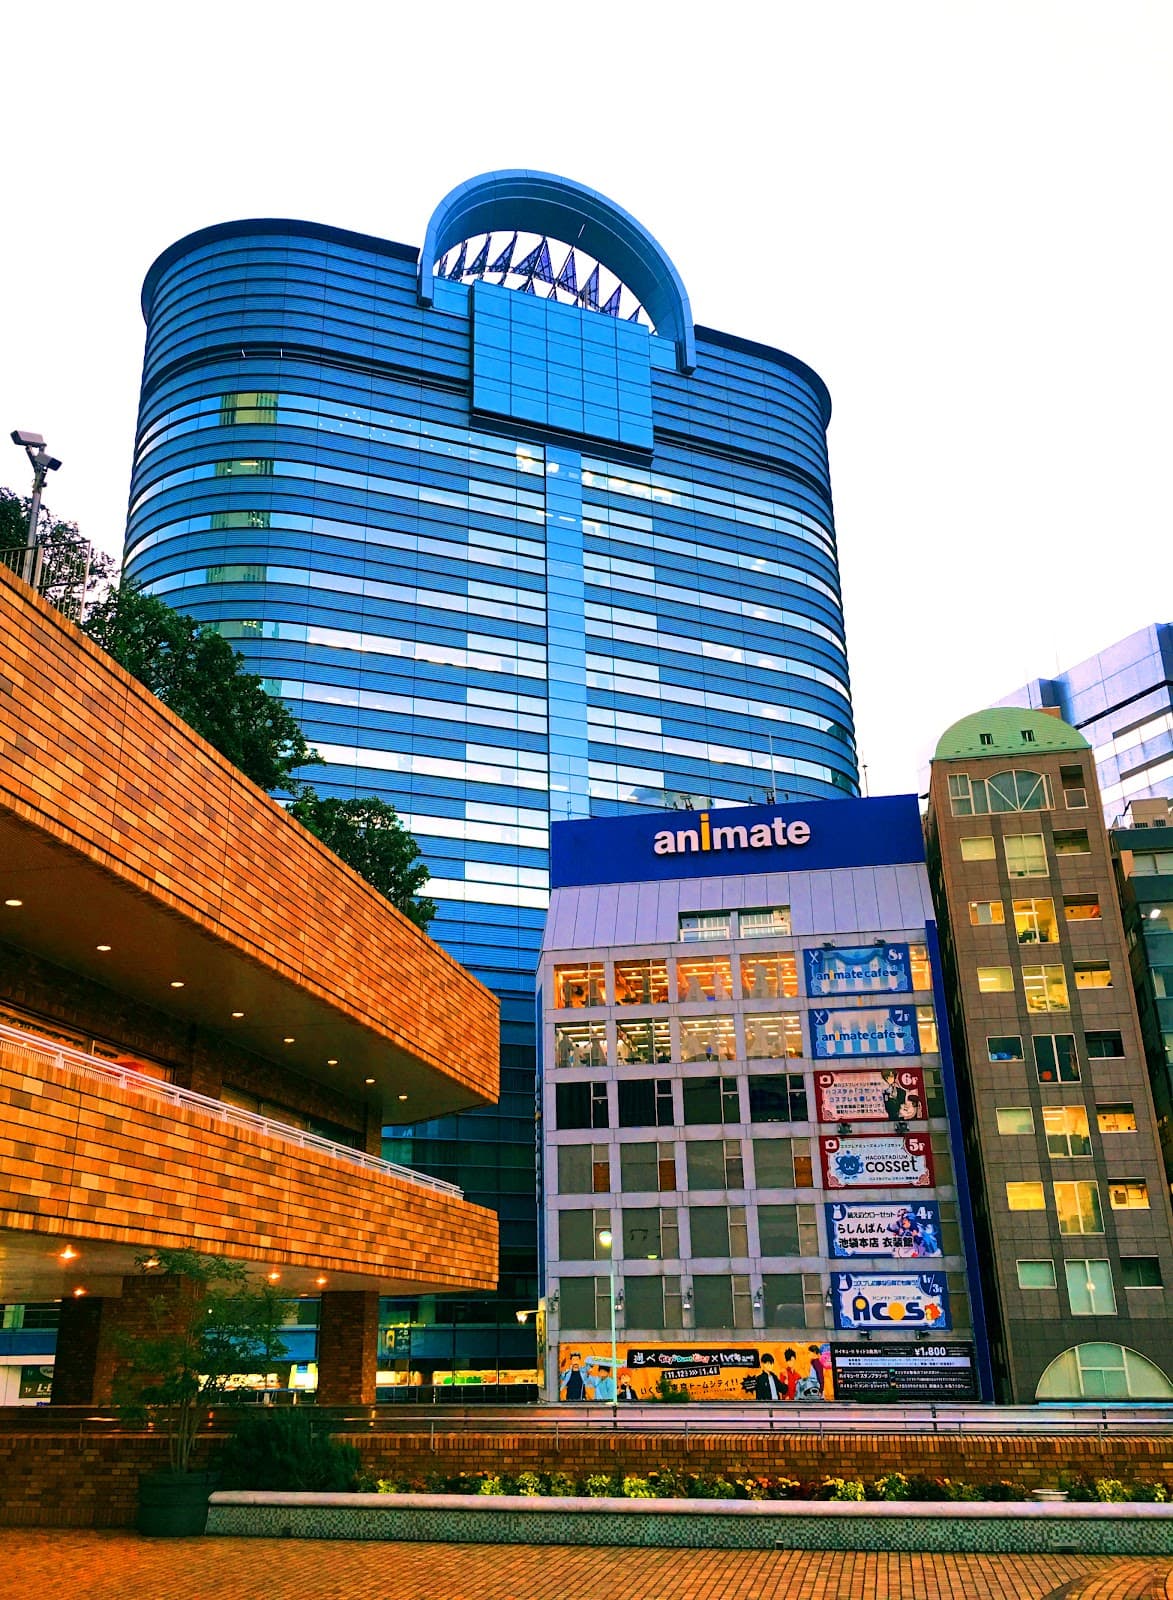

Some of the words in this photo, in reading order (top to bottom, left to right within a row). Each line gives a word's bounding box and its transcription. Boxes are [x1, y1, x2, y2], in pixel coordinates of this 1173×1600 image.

[653, 813, 811, 855] animate
[816, 969, 863, 981] animate
[864, 968, 890, 978] cafe
[895, 1009, 910, 1022] 7F
[821, 1030, 869, 1042] animate
[870, 1030, 896, 1040] cafe
[901, 1073, 919, 1085] 6F
[909, 1139, 926, 1152] 5F
[865, 1156, 919, 1173] cosset
[916, 1206, 934, 1220] 4F
[838, 1223, 886, 1234] らしんばん
[839, 1237, 879, 1248] 池袋本店
